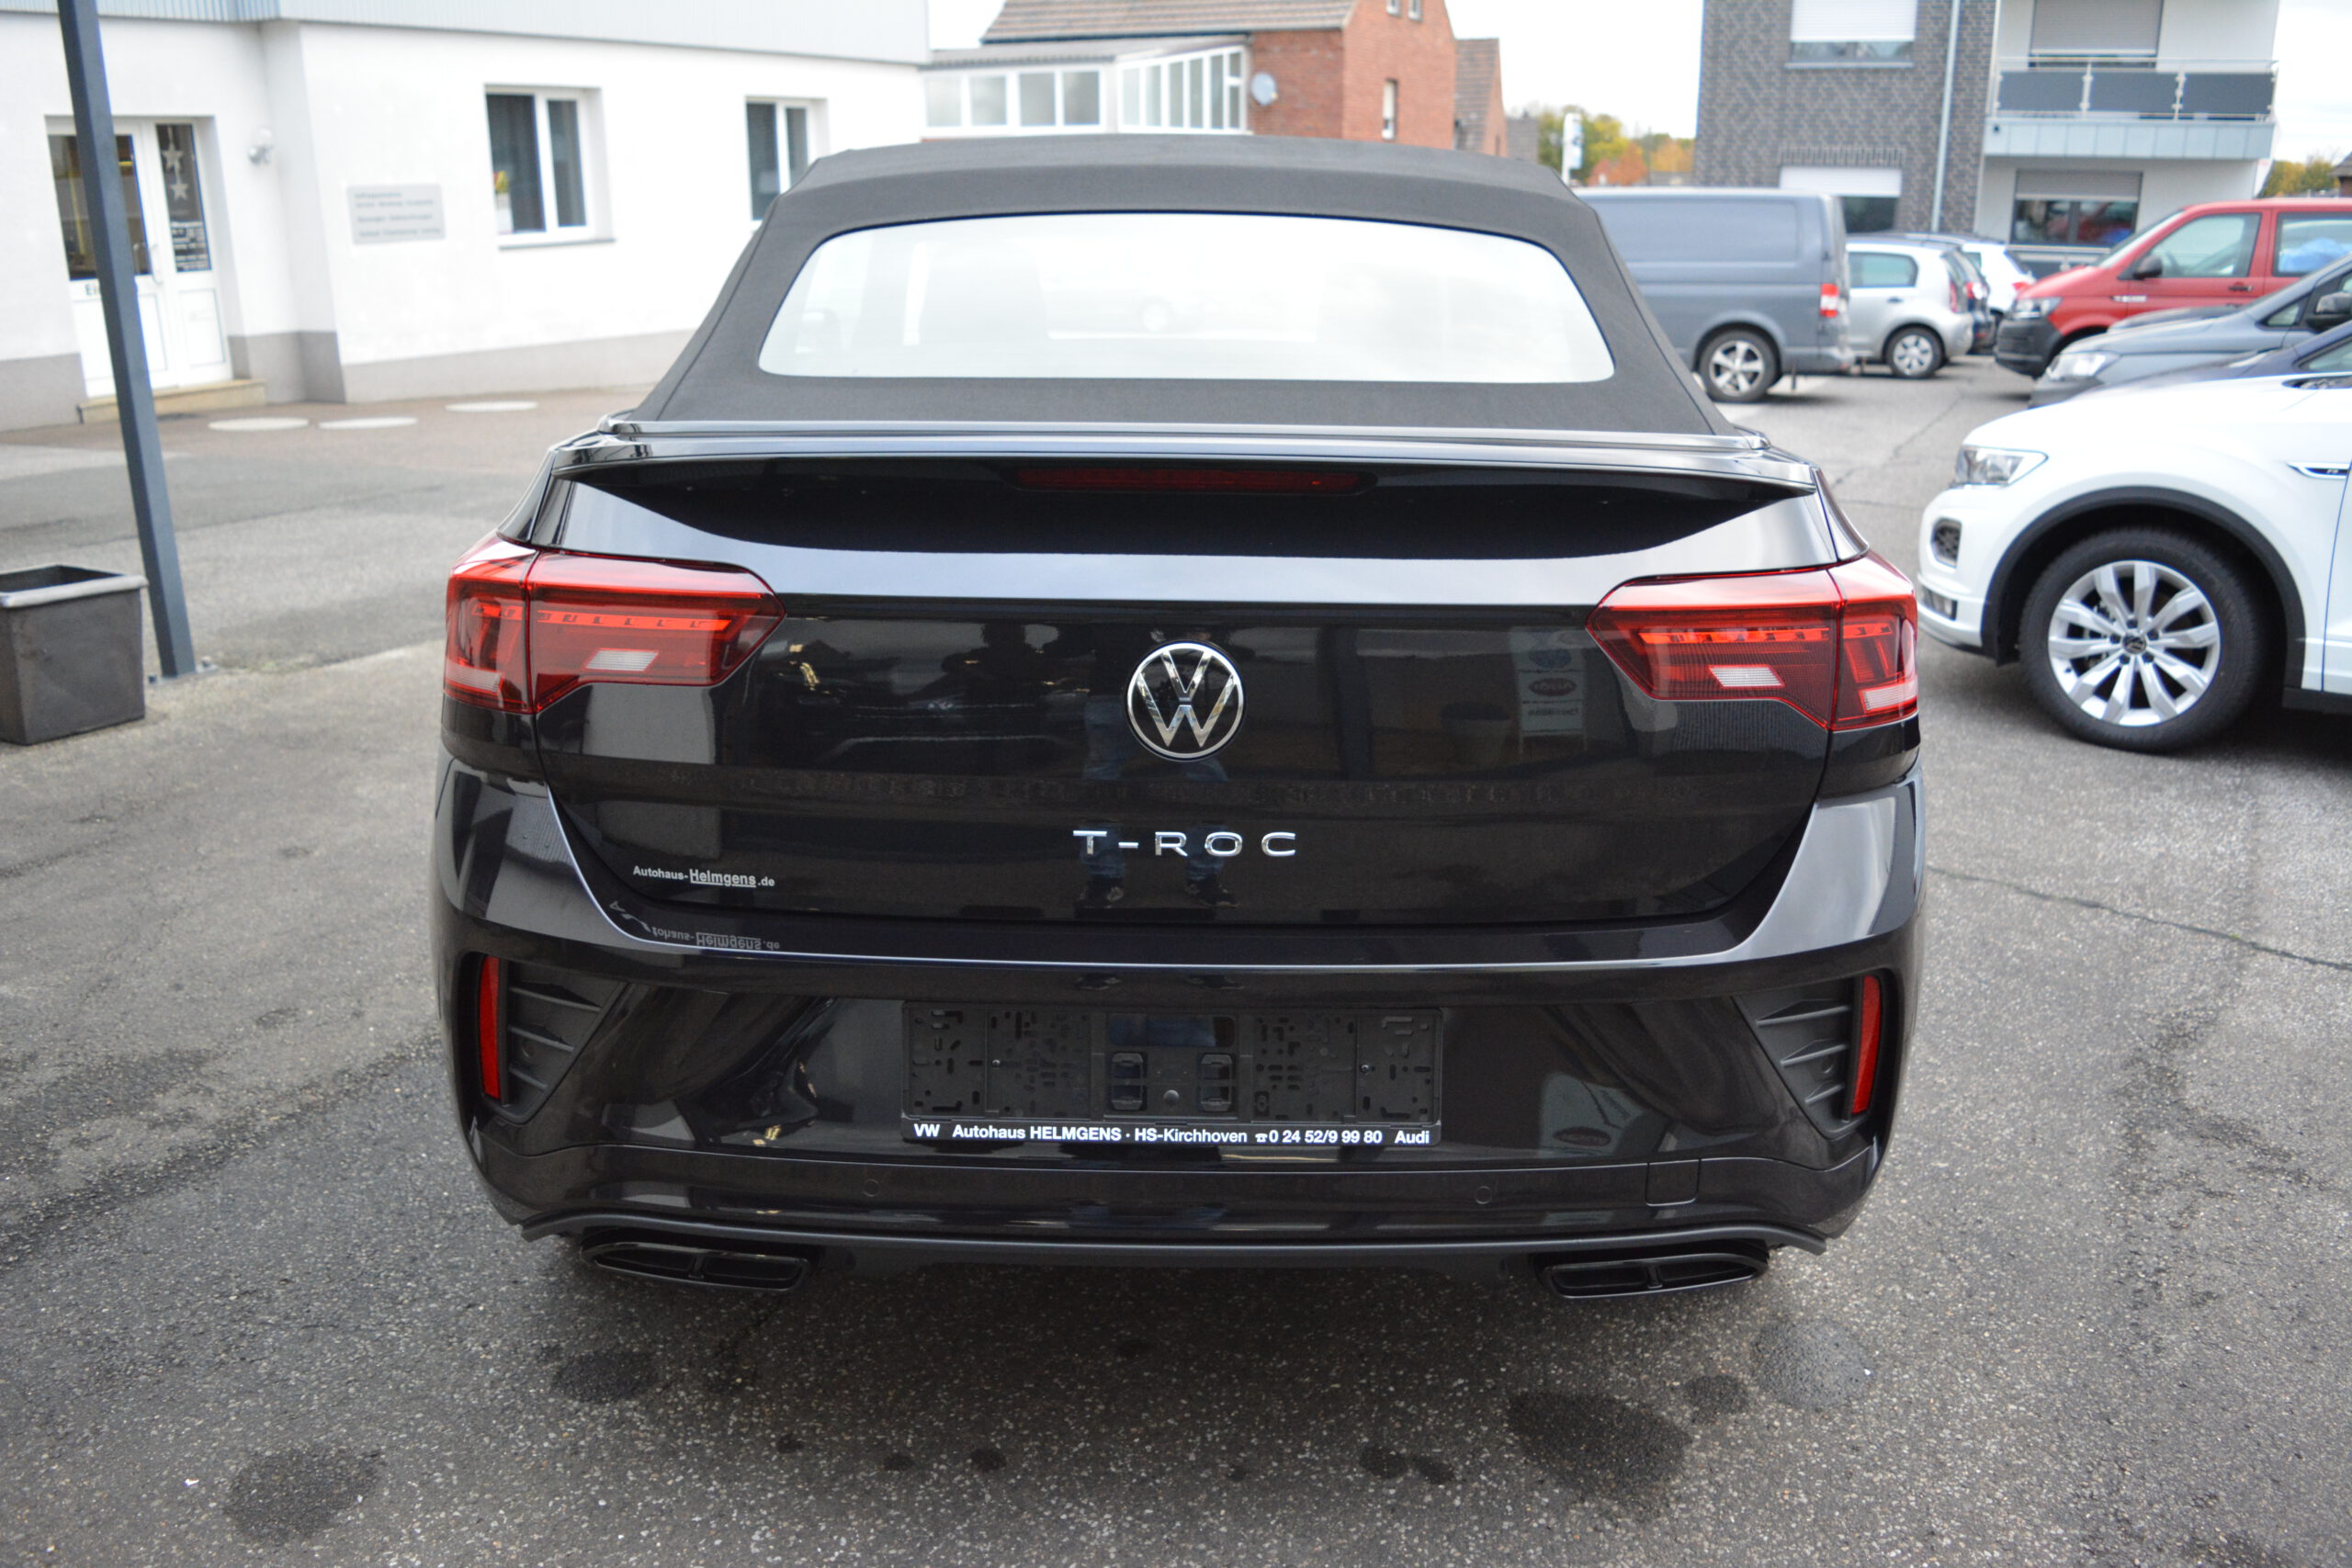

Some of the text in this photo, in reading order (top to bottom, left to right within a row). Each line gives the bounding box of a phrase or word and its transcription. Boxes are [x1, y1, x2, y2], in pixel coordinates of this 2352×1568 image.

[1072, 829, 1296, 857] T-ROC
[913, 1123, 941, 1137] VW
[952, 1124, 1026, 1139] Autohaus
[1030, 1126, 1122, 1141] HELMGENS
[1135, 1128, 1248, 1143] HS-Kirchhoven
[1283, 1130, 1302, 1144] 24
[1304, 1130, 1339, 1144] 52/9
[1341, 1131, 1361, 1144] 99
[1363, 1131, 1383, 1144] 80
[1394, 1131, 1430, 1144] Audi
